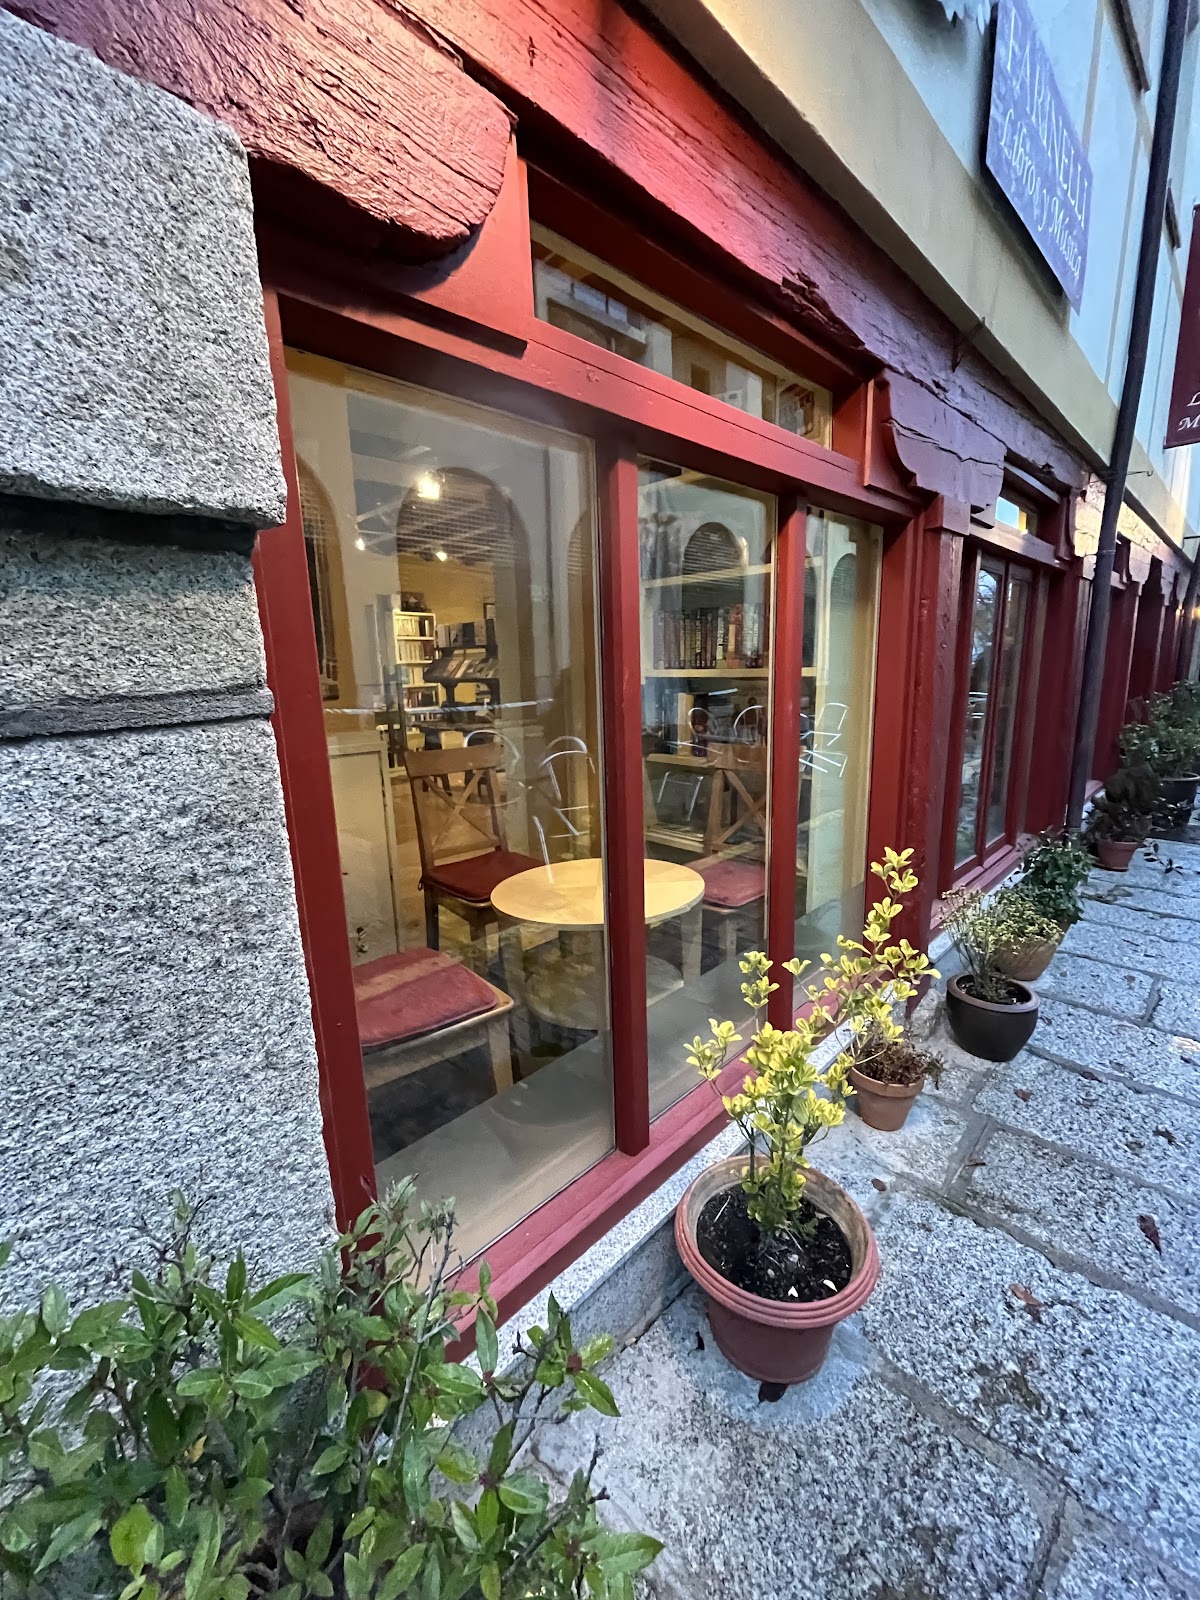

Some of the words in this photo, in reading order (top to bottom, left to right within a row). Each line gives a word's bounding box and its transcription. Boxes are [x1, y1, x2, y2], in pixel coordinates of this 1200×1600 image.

[1000, 108, 1041, 205] Libros
[1038, 188, 1050, 231] y
[1049, 196, 1081, 280] Música
[1006, 6, 1088, 230] FARINELLI
